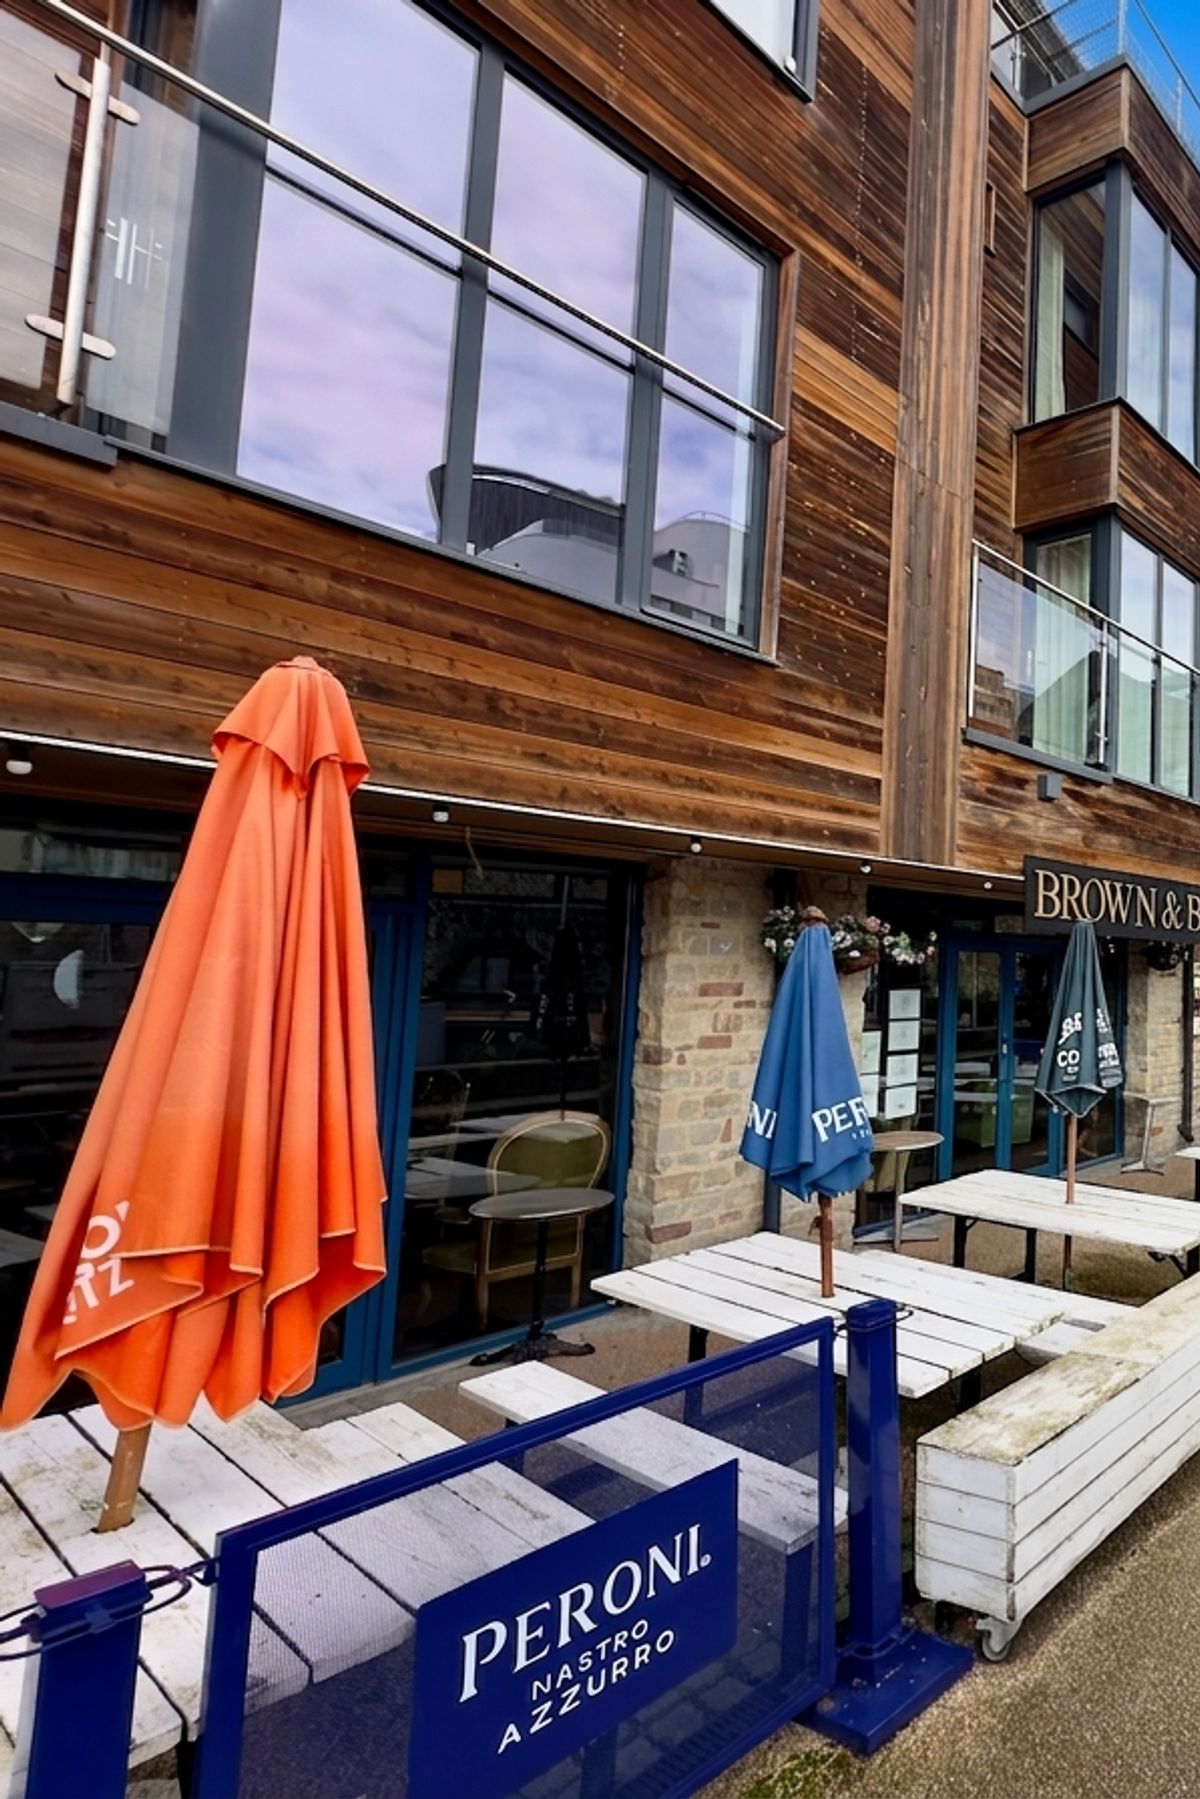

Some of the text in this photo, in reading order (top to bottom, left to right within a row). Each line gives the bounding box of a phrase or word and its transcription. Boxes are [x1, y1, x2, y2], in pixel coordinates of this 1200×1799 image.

[1034, 869, 1158, 928] BROWN
[1161, 890, 1184, 930] &
[459, 1524, 702, 1703] PERONI
[531, 1618, 649, 1701] NASTRO
[497, 1629, 675, 1755] AZZURRO
